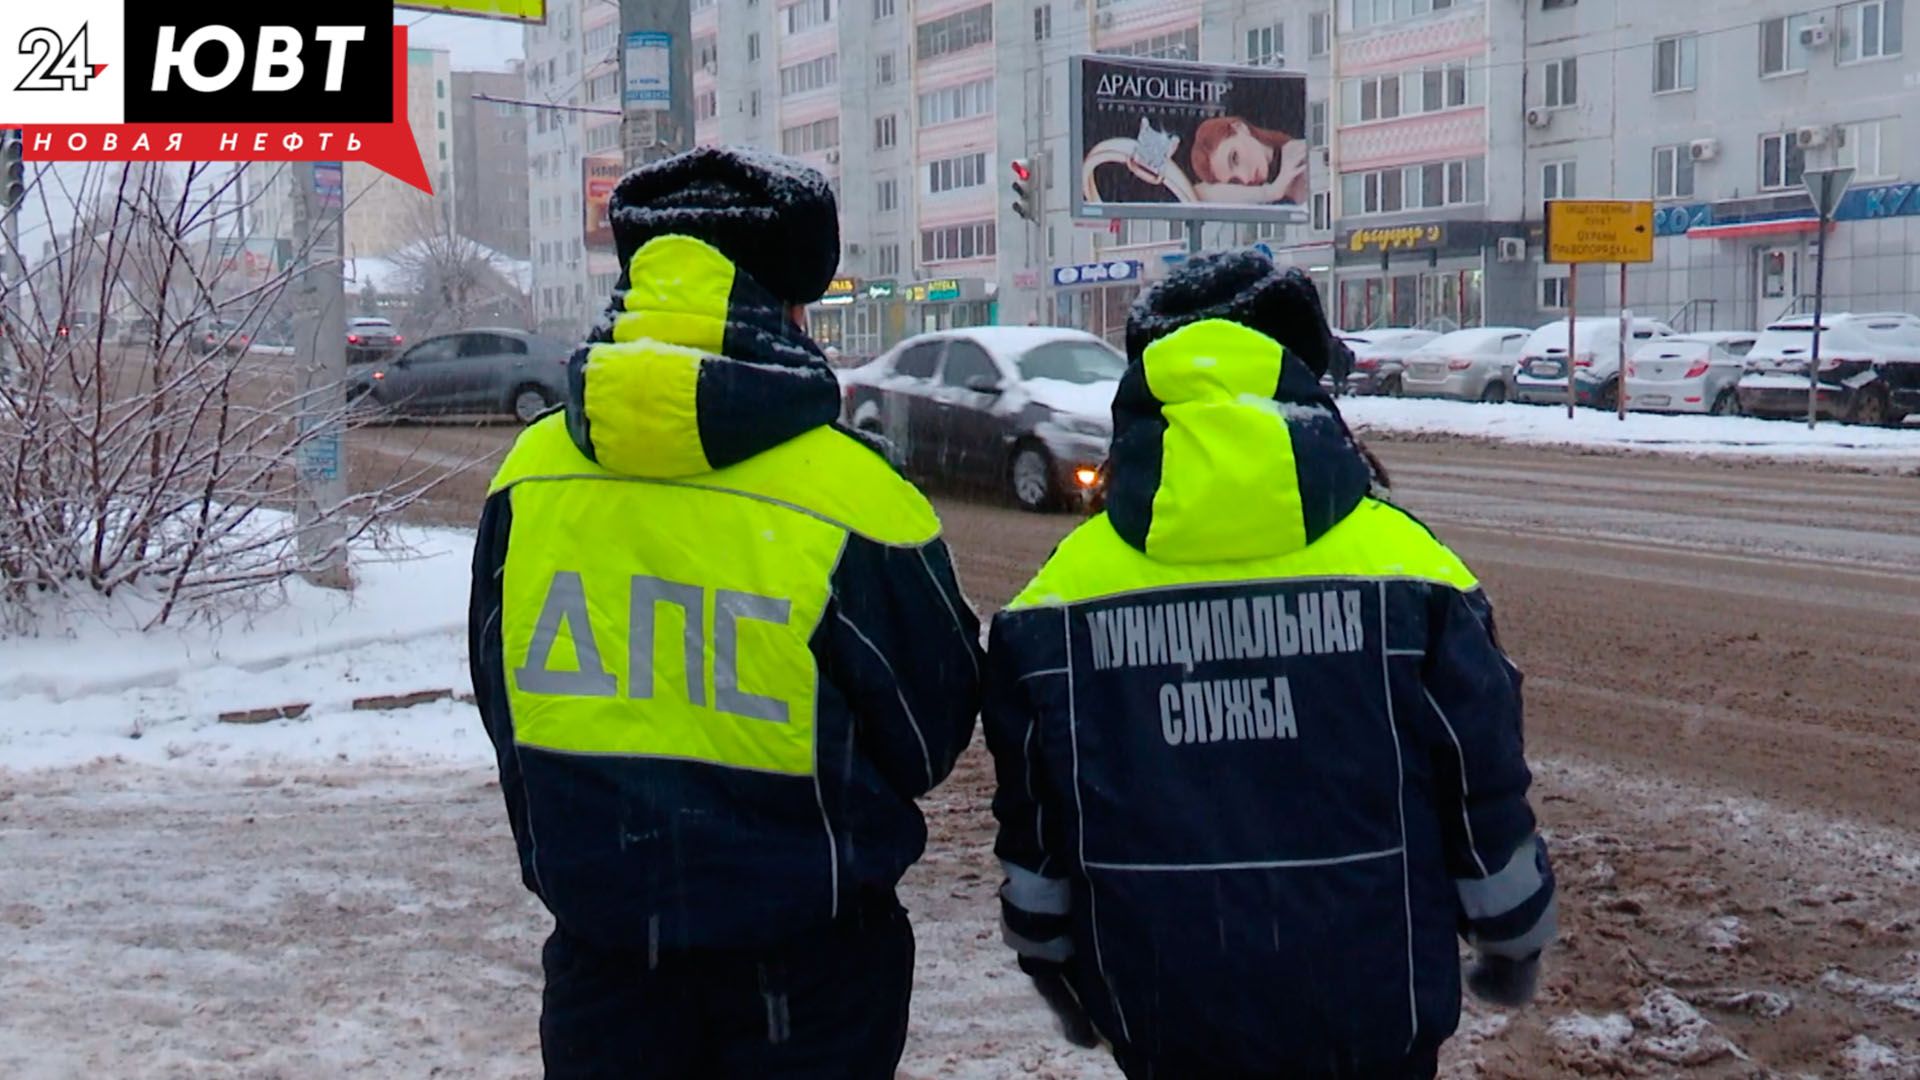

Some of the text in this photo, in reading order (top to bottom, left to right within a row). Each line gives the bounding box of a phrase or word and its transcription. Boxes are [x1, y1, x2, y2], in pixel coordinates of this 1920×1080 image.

[513, 569, 792, 724] ДПС
[1086, 589, 1364, 672] МУНИЦИПАЛЬНАЯ
[1159, 676, 1298, 746] СЛУЖБА
